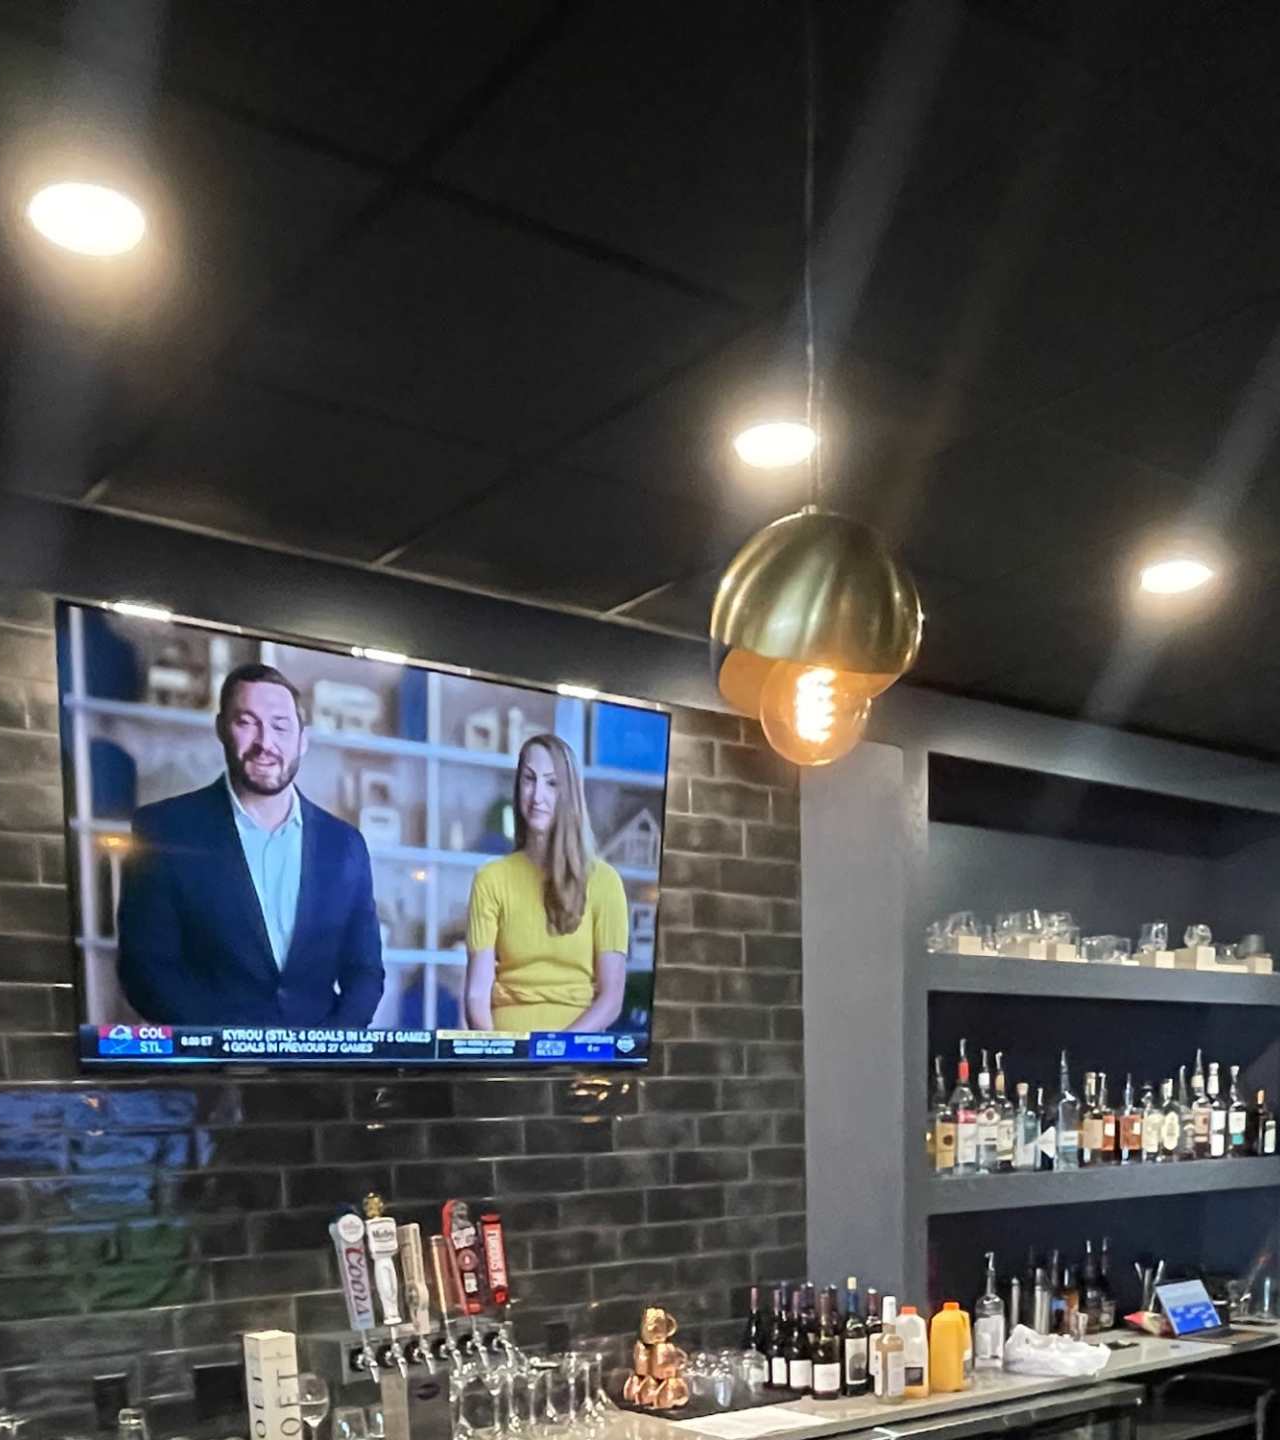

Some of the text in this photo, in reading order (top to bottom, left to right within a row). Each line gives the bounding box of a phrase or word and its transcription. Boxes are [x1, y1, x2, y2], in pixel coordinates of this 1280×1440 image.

[138, 1027, 166, 1039] COL
[222, 1029, 263, 1041] KYROU
[265, 1029, 297, 1043] (STL):
[298, 1030, 306, 1042] 4
[307, 1030, 345, 1042] GOALS
[346, 1031, 359, 1042] IN
[360, 1031, 385, 1042] LAST
[386, 1031, 394, 1042] 5
[395, 1032, 431, 1043] GAMES
[139, 1041, 163, 1053] STL
[222, 1042, 230, 1052] 4
[231, 1042, 265, 1052] GOALS
[266, 1042, 277, 1052] IN
[278, 1042, 326, 1053] PREVIOUS
[340, 1043, 373, 1053] GAMES
